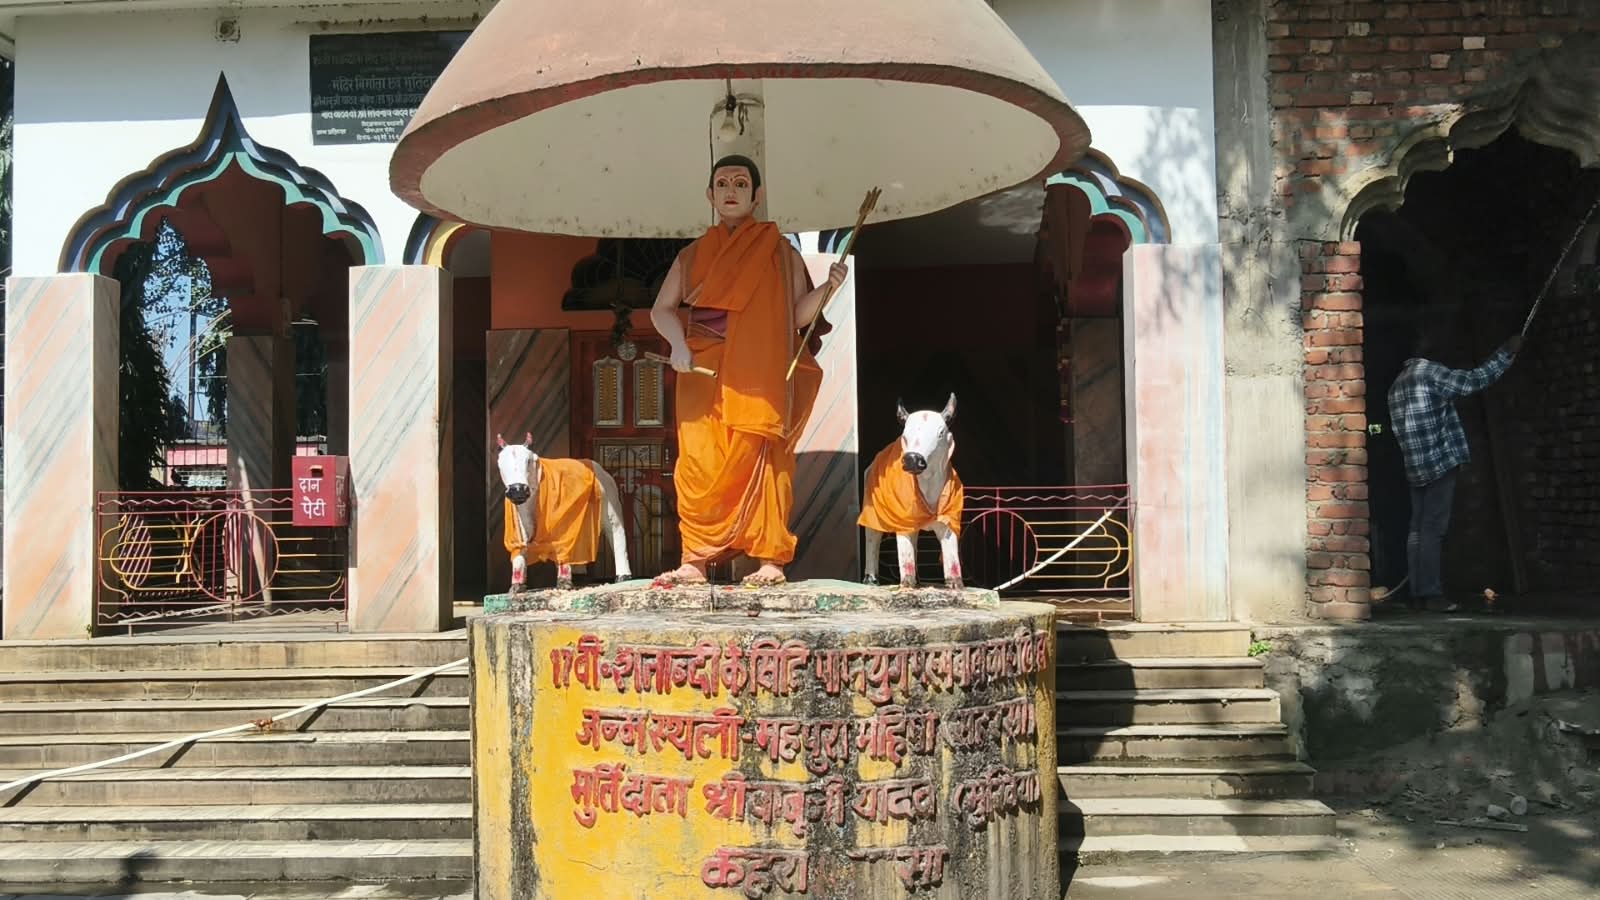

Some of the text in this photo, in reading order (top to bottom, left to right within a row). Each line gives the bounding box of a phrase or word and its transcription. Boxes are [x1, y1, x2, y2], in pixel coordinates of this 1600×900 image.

[298, 477, 323, 494] दान
[300, 496, 327, 519] पेटी
[721, 639, 746, 698] के
[852, 775, 937, 824] यादव
